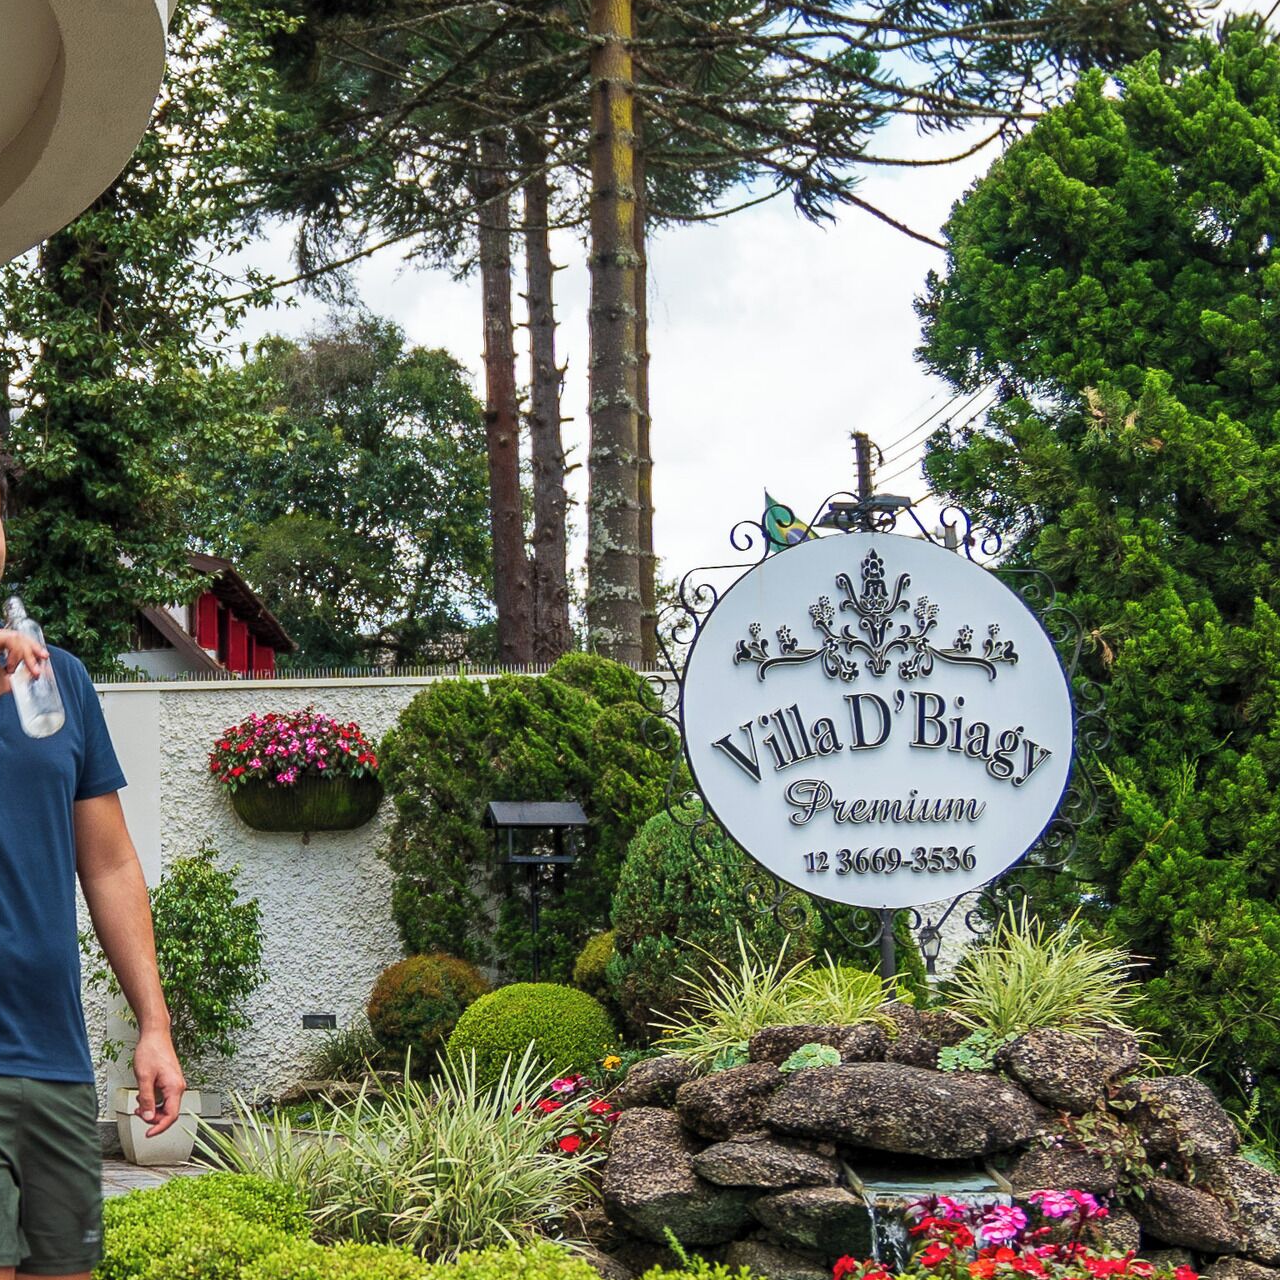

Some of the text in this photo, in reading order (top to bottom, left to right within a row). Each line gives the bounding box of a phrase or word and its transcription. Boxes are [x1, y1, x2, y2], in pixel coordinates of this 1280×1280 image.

[711, 688, 1053, 787] Villa D'Biagy
[784, 778, 987, 825] Premium
[803, 844, 977, 875] 12 3669-3536
